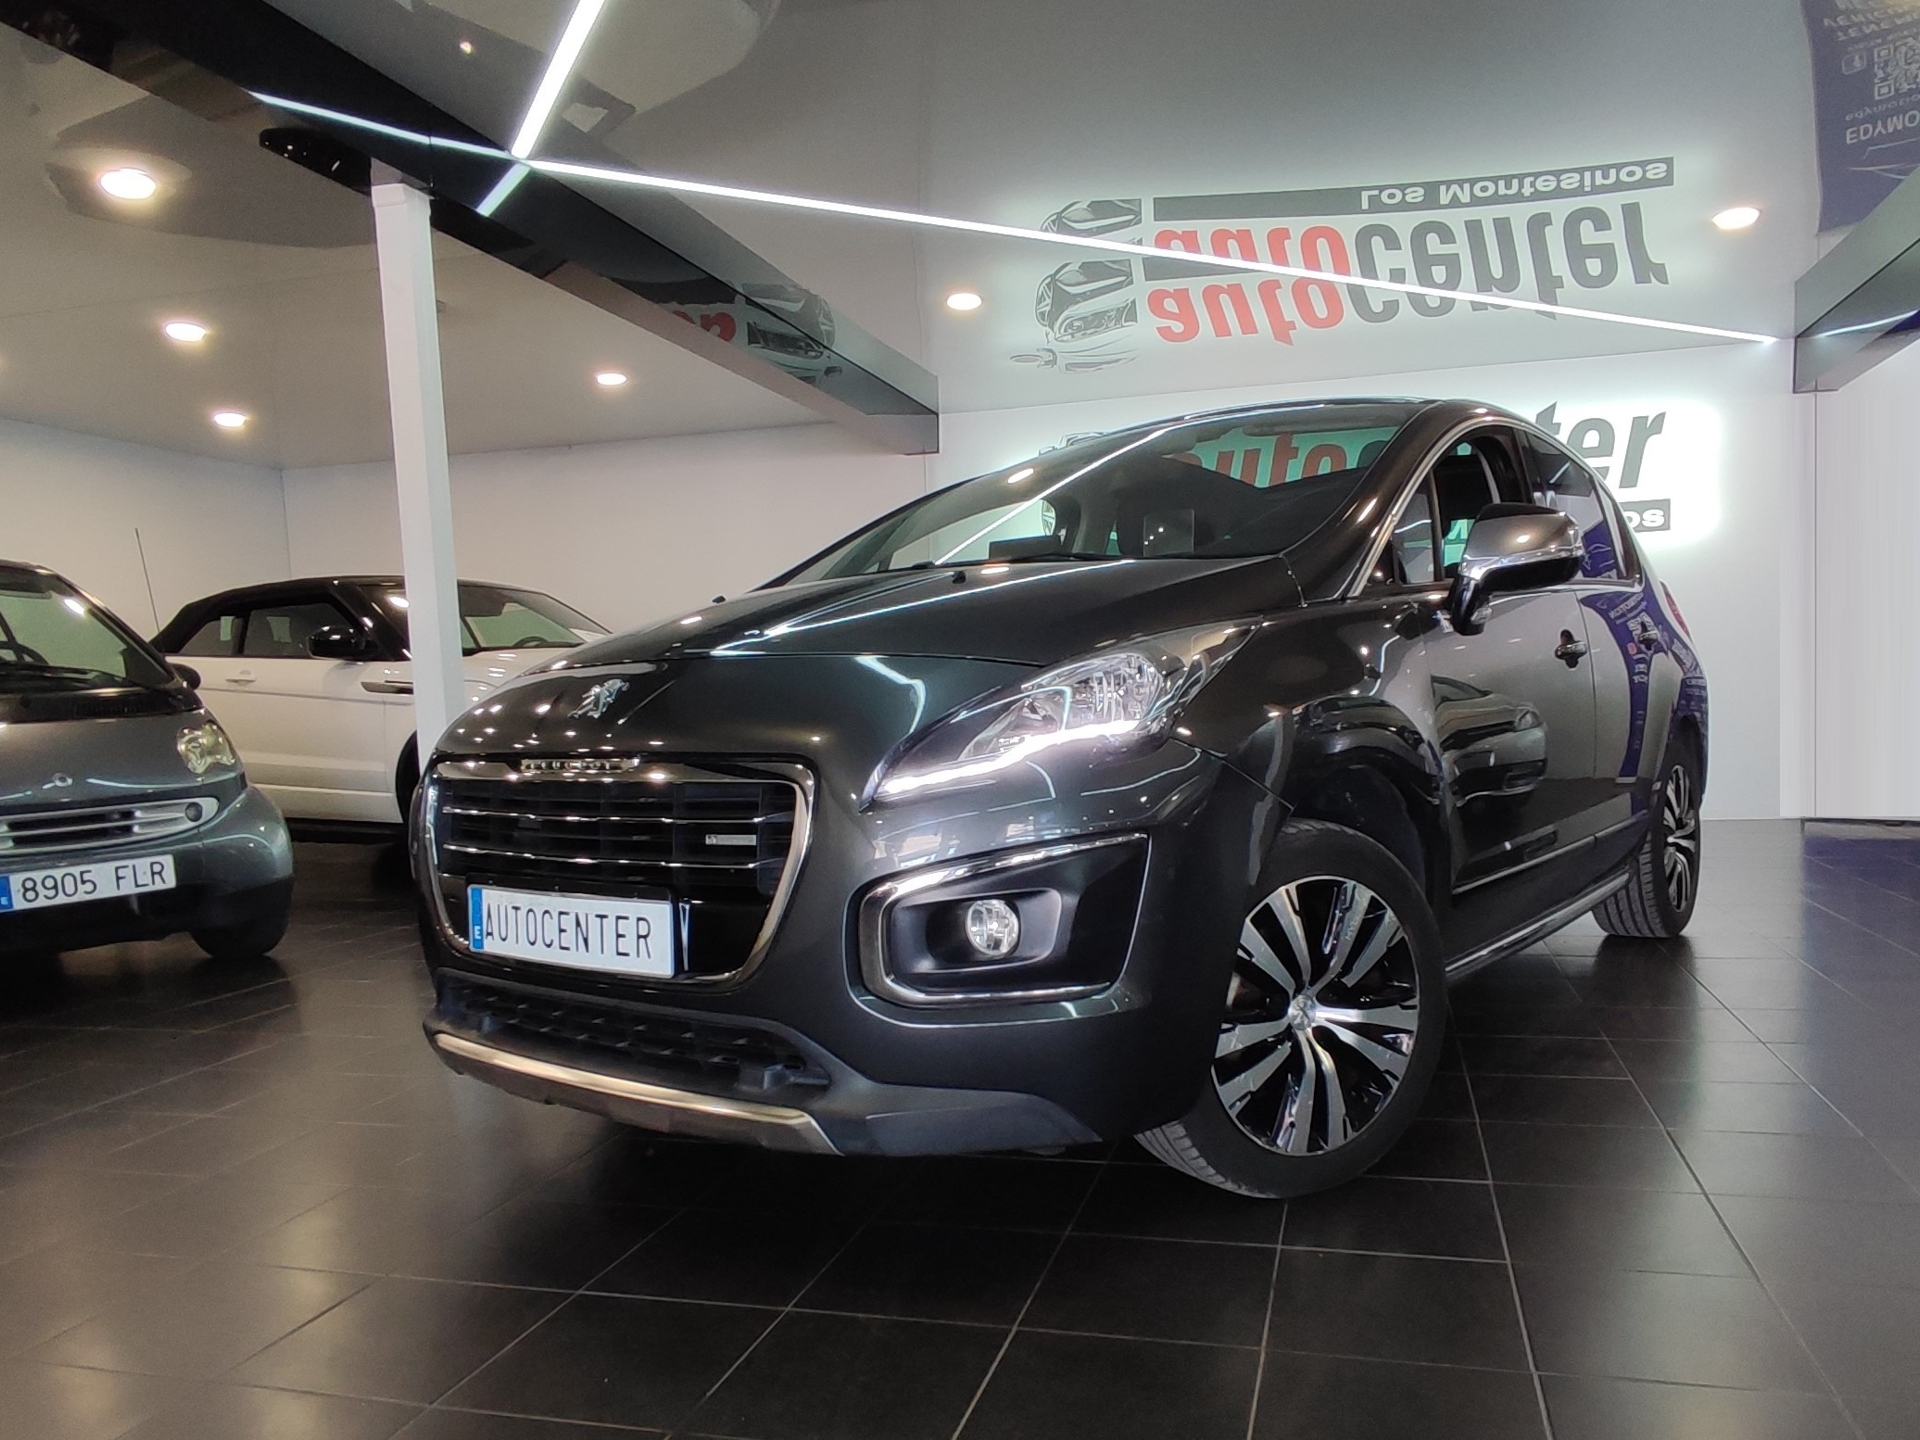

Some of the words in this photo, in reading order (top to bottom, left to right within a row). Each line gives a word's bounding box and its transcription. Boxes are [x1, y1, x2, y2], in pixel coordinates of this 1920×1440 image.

[21, 869, 97, 903] 8905
[114, 861, 166, 891] FLR
[484, 903, 652, 960] AUTOCENTER
